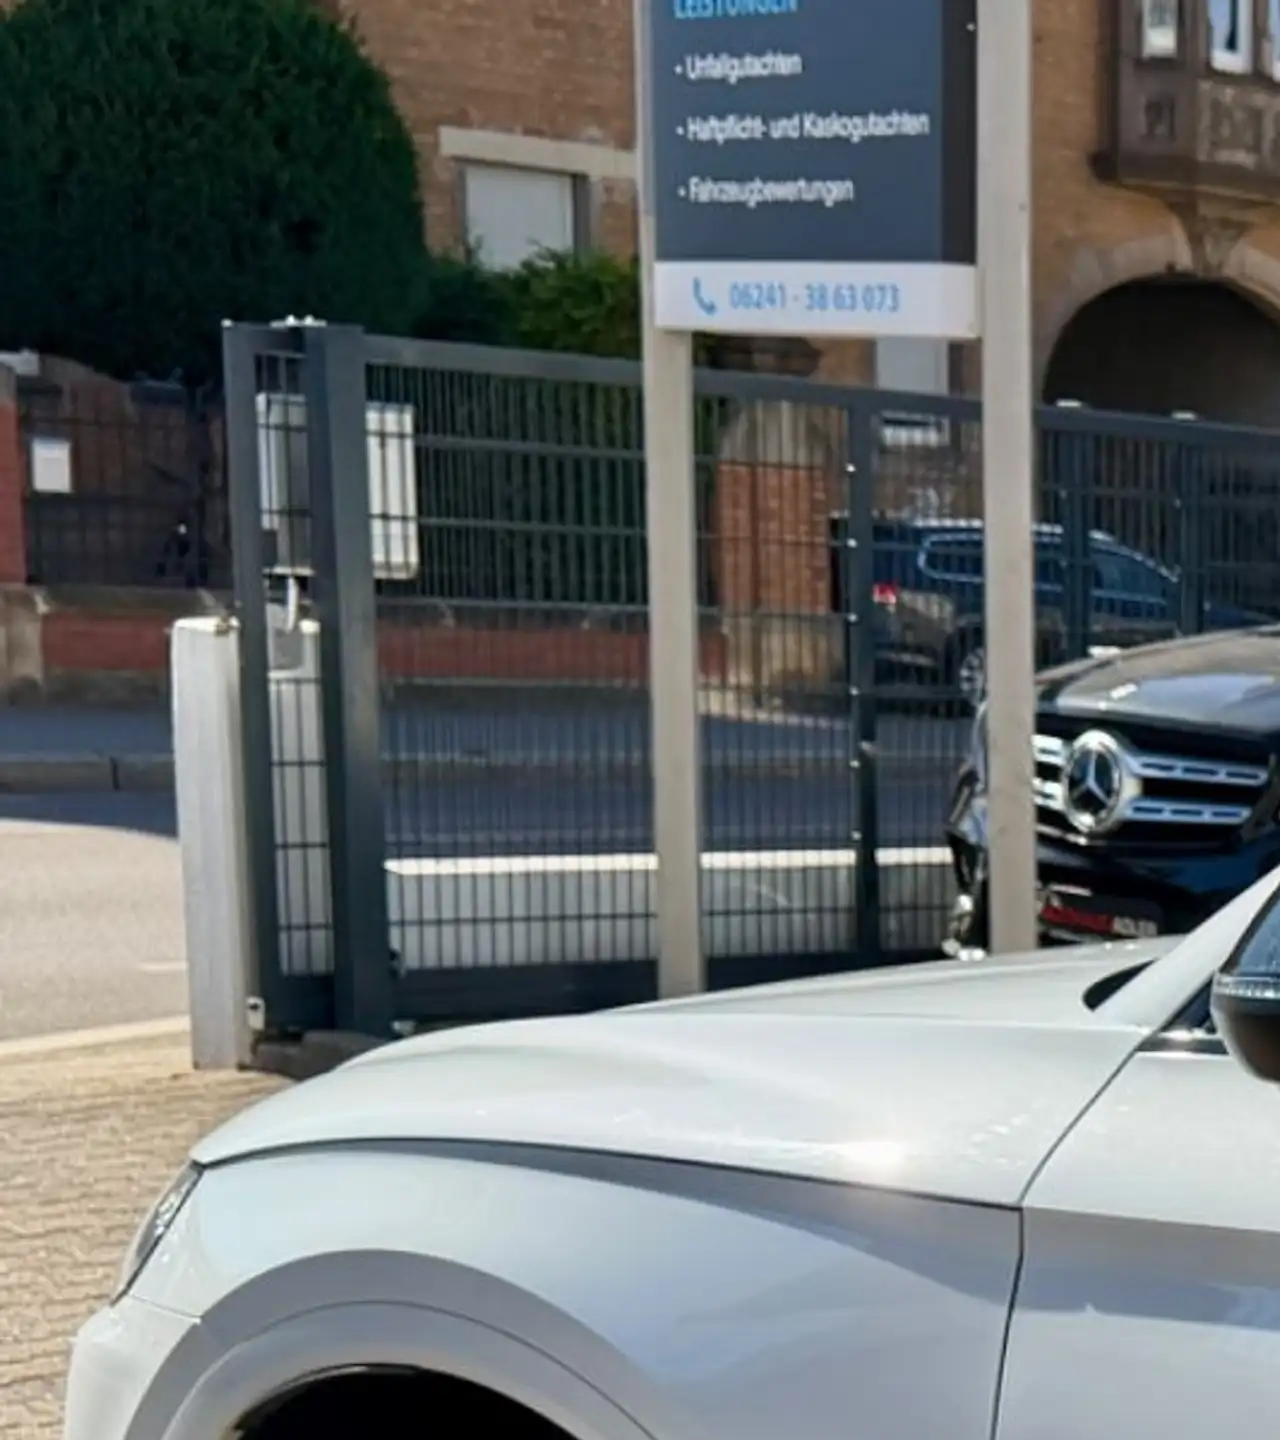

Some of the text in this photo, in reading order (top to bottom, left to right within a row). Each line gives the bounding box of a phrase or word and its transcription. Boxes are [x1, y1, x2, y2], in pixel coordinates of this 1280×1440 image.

[685, 50, 802, 84] Unfallgutachten
[769, 112, 799, 139] und
[730, 281, 786, 310] 06241
